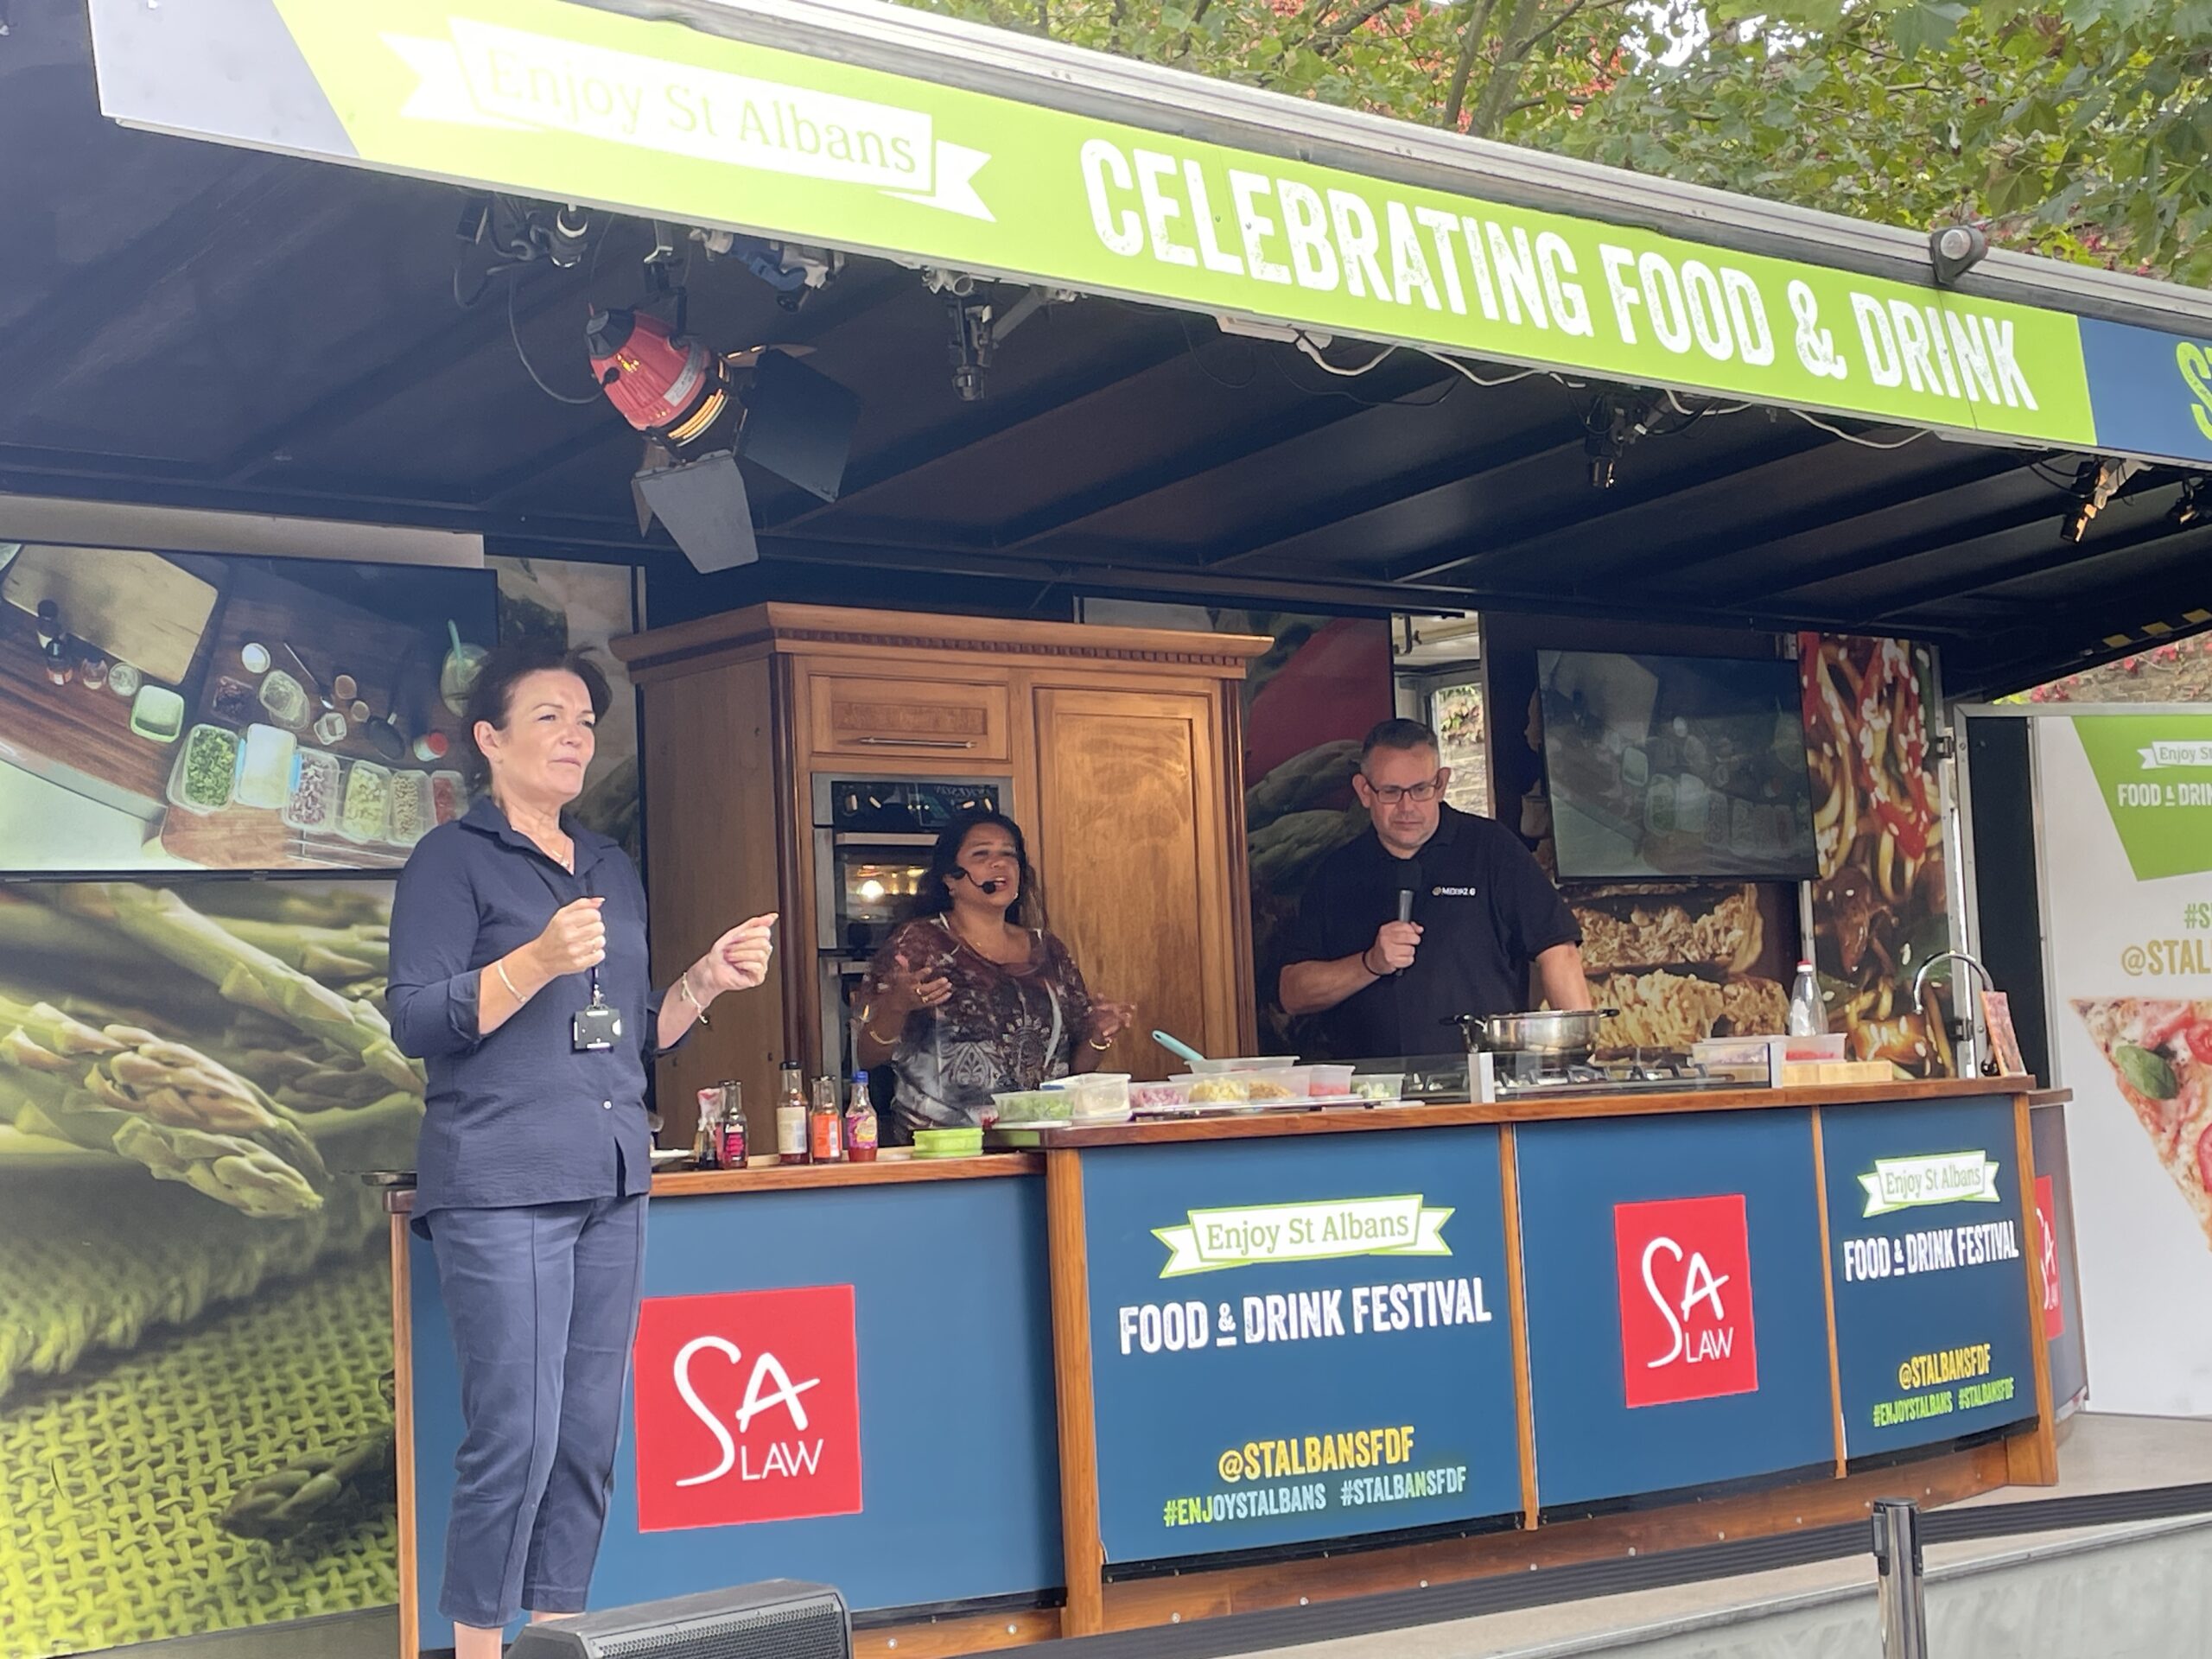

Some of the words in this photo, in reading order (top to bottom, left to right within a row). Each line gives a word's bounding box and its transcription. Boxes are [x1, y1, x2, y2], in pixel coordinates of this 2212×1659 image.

[486, 45, 645, 136] Enjoy
[667, 84, 719, 137] St
[739, 99, 918, 175] Albans
[1080, 139, 1594, 337] CELEBRATING
[1599, 244, 1776, 368] FOOD
[1787, 279, 1848, 380] &
[1849, 291, 2039, 411] DRINK
[2177, 341, 2212, 441] S
[2159, 746, 2196, 763] Enjoy
[2118, 784, 2162, 807] FOOD
[2165, 785, 2176, 806] &
[2184, 902, 2212, 929] #S
[2121, 939, 2212, 976] @STAL
[1885, 1171, 1923, 1198] Enjoy
[1925, 1170, 1938, 1190] St
[1942, 1165, 1981, 1189] Albans
[1207, 1221, 1281, 1255] Enjoy
[1288, 1217, 1313, 1244] St
[1322, 1212, 1408, 1242] Albans
[1843, 1236, 1891, 1282] FOOD
[1893, 1239, 1905, 1276] &
[1905, 1228, 1956, 1274] DRINK
[1957, 1220, 2019, 1267] FESTIVAL
[1119, 1301, 1209, 1355] FOOD
[1217, 1302, 1237, 1346] &
[1243, 1289, 1345, 1344] DRINK
[1351, 1277, 1492, 1334] FESTIVAL
[1642, 1236, 1730, 1368] SA
[1685, 1327, 1734, 1363] LAW
[1898, 1344, 1991, 1390] @STALBANSFDF
[673, 1335, 821, 1487] SA
[1873, 1391, 1953, 1427] #ENJOYSTALBANS
[1958, 1377, 2014, 1410] #STALBANSFDF
[741, 1439, 824, 1481] LAW
[1218, 1426, 1414, 1483] @STALBANSFDF
[1163, 1483, 1327, 1527] #ENJOYSTALBANS
[1340, 1466, 1467, 1506] #STALBANSFDF
